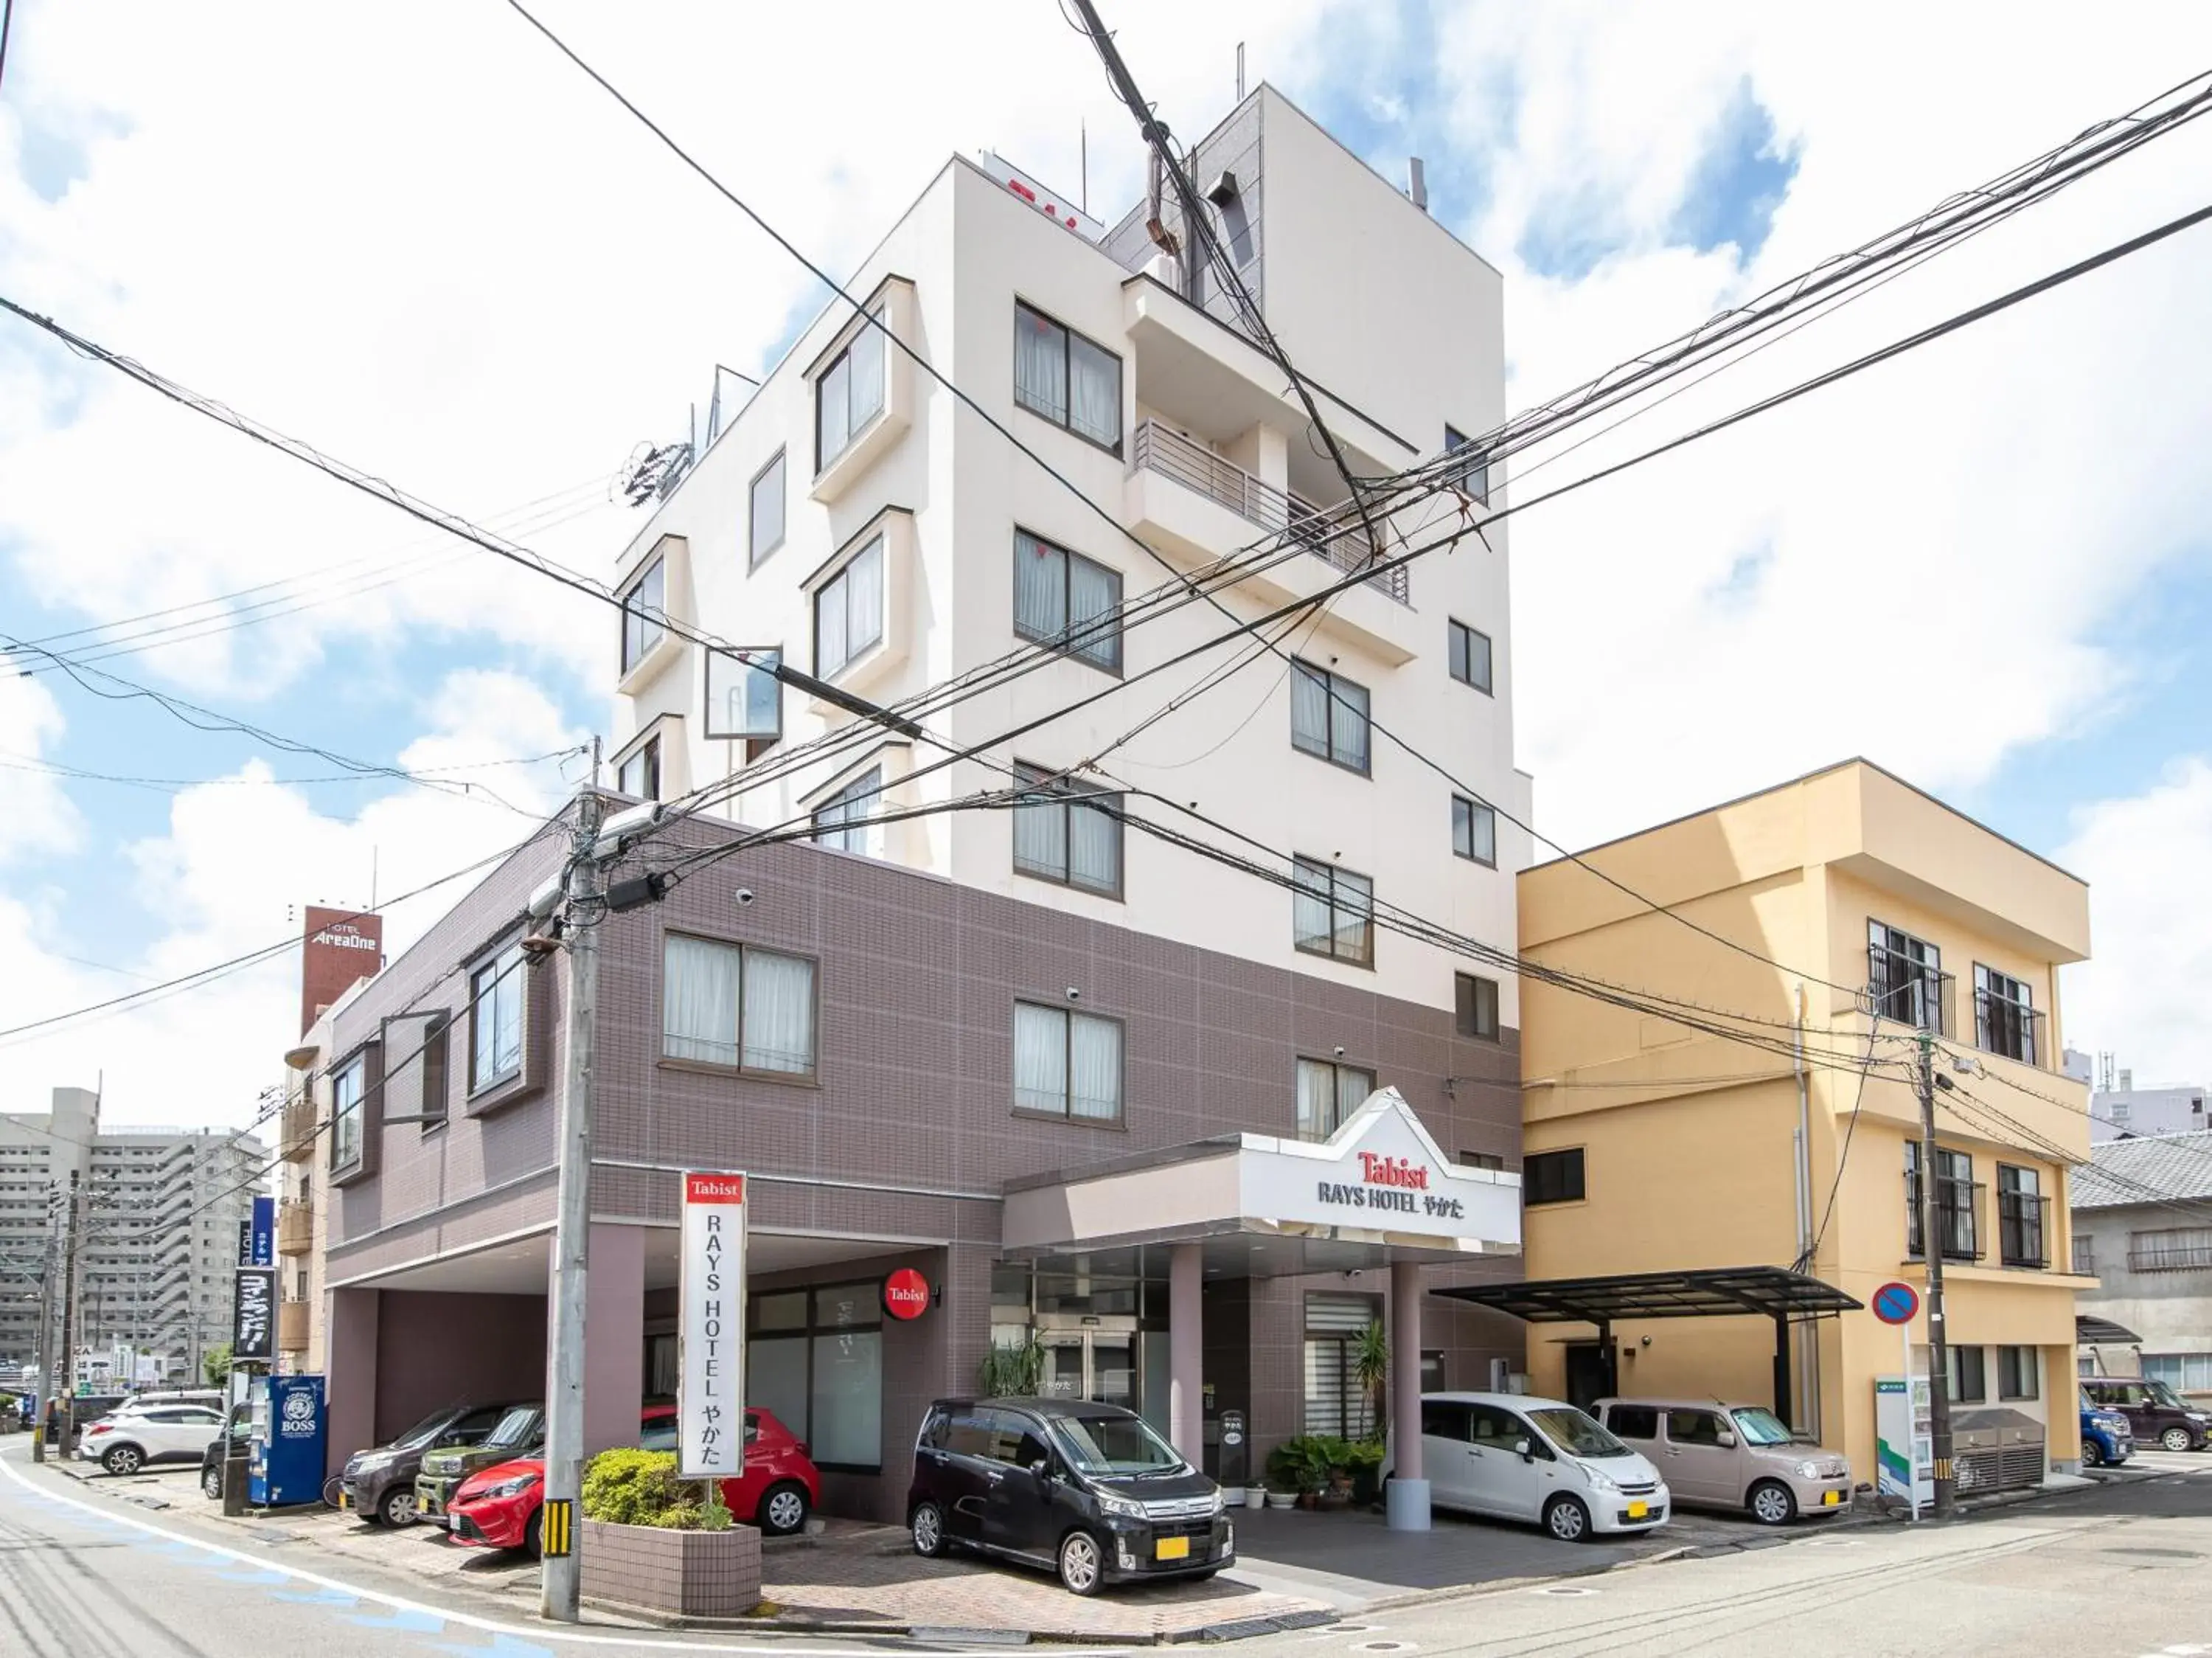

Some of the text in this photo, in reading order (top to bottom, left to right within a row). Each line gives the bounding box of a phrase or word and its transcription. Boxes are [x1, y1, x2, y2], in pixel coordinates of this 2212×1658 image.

[327, 923, 361, 934] HOTEL
[311, 931, 377, 951] AreaOne
[1357, 1151, 1430, 1190] Tabist
[691, 1181, 739, 1196] Tabist
[1318, 1182, 1465, 1219] RAYS HOTEL やかた
[888, 1287, 925, 1302] Tabist
[702, 1215, 721, 1466] RAYS HOTEL やかた
[281, 1420, 316, 1432] BOSS
